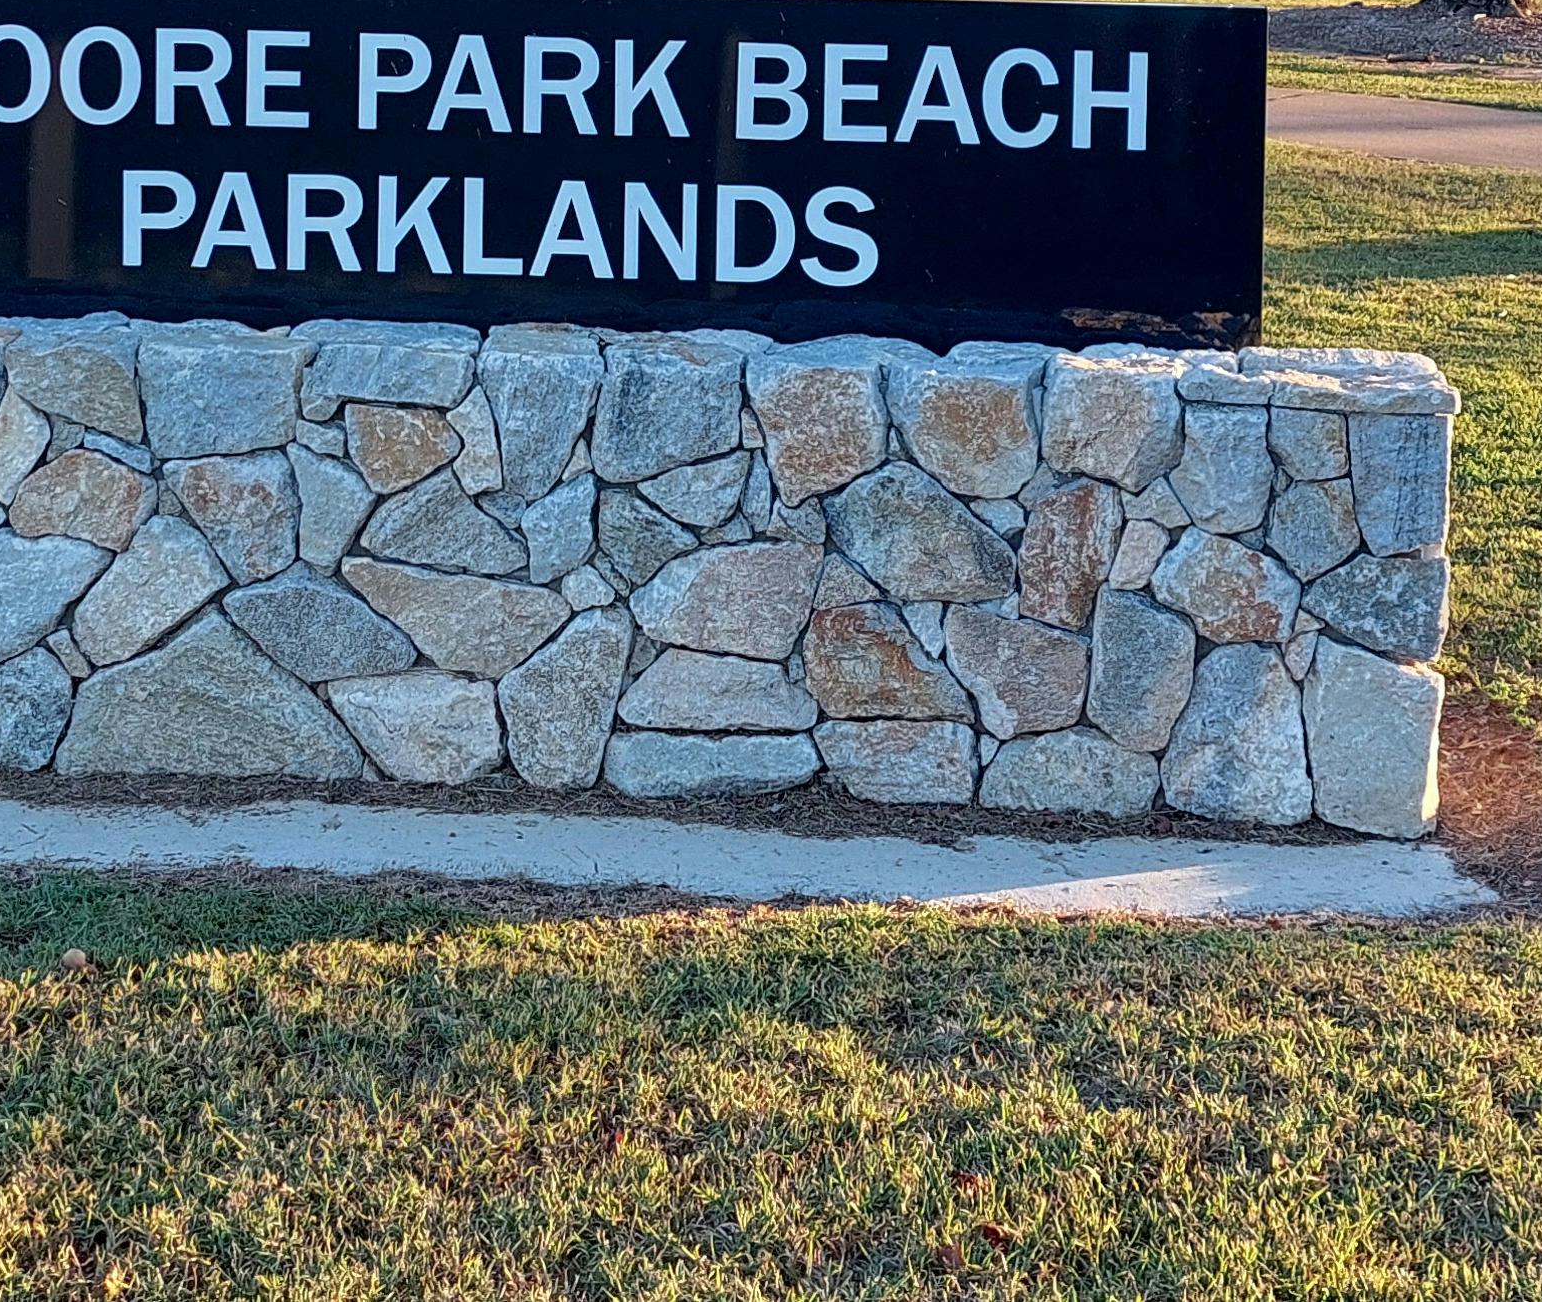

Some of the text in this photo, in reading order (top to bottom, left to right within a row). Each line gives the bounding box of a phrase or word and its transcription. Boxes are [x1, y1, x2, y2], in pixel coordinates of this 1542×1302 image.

[358, 32, 690, 138] PARK
[735, 41, 1149, 151] BEACH
[122, 169, 879, 287] PARKLANDS
